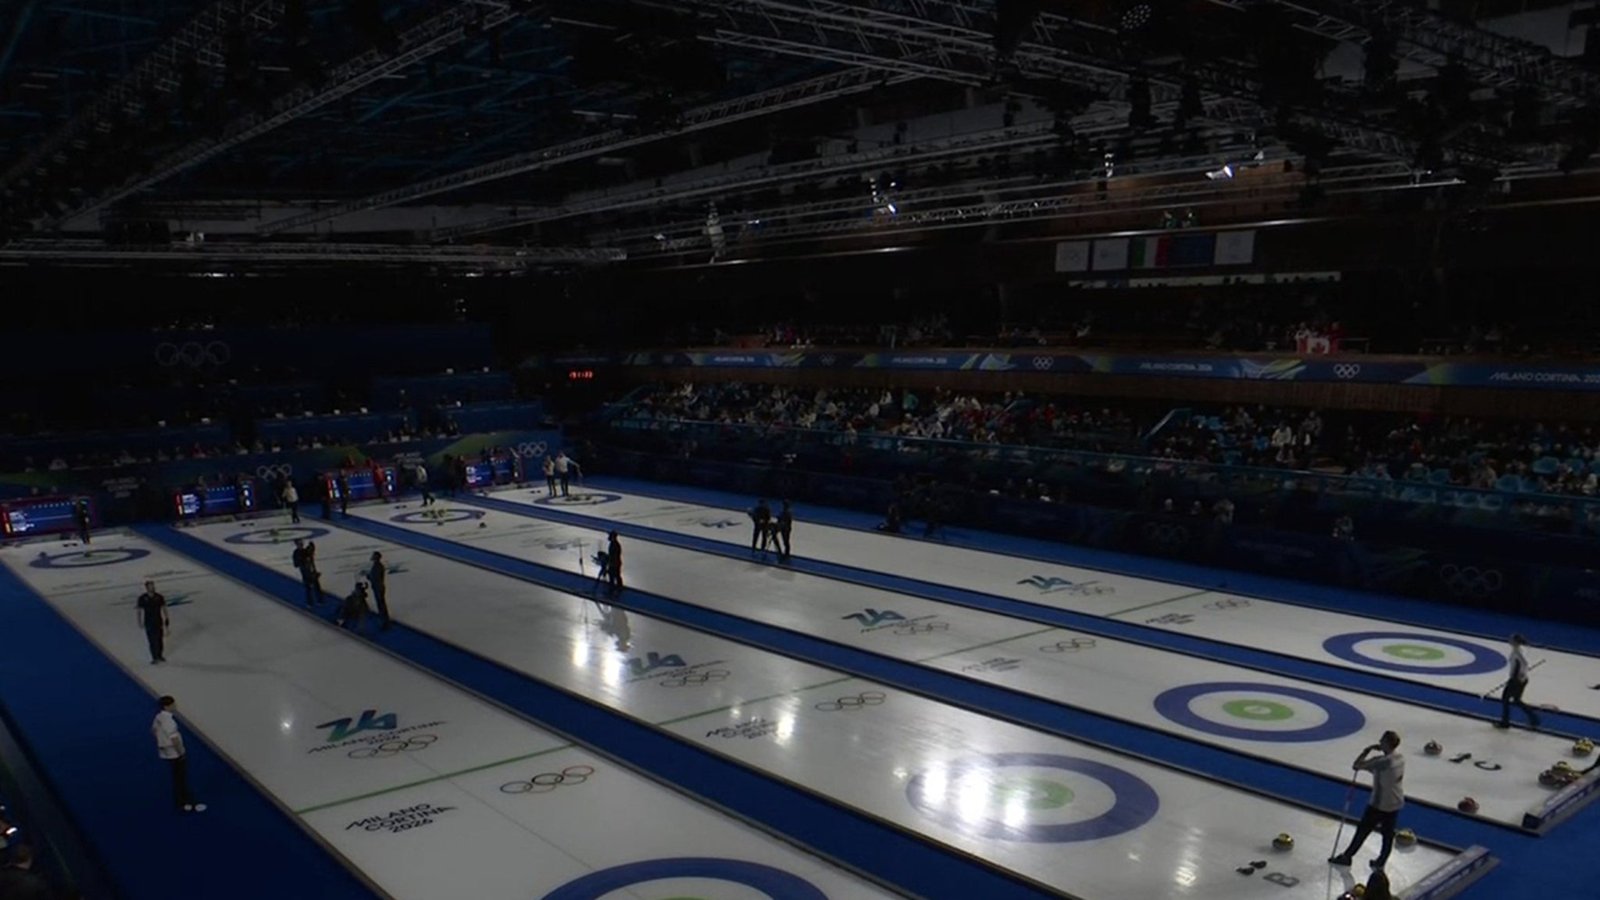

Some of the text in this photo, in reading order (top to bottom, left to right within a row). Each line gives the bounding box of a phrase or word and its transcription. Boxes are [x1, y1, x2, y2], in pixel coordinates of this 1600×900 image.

[345, 803, 430, 830] MILANO
[365, 807, 458, 831] CORTINA
[388, 819, 433, 833] 2026
